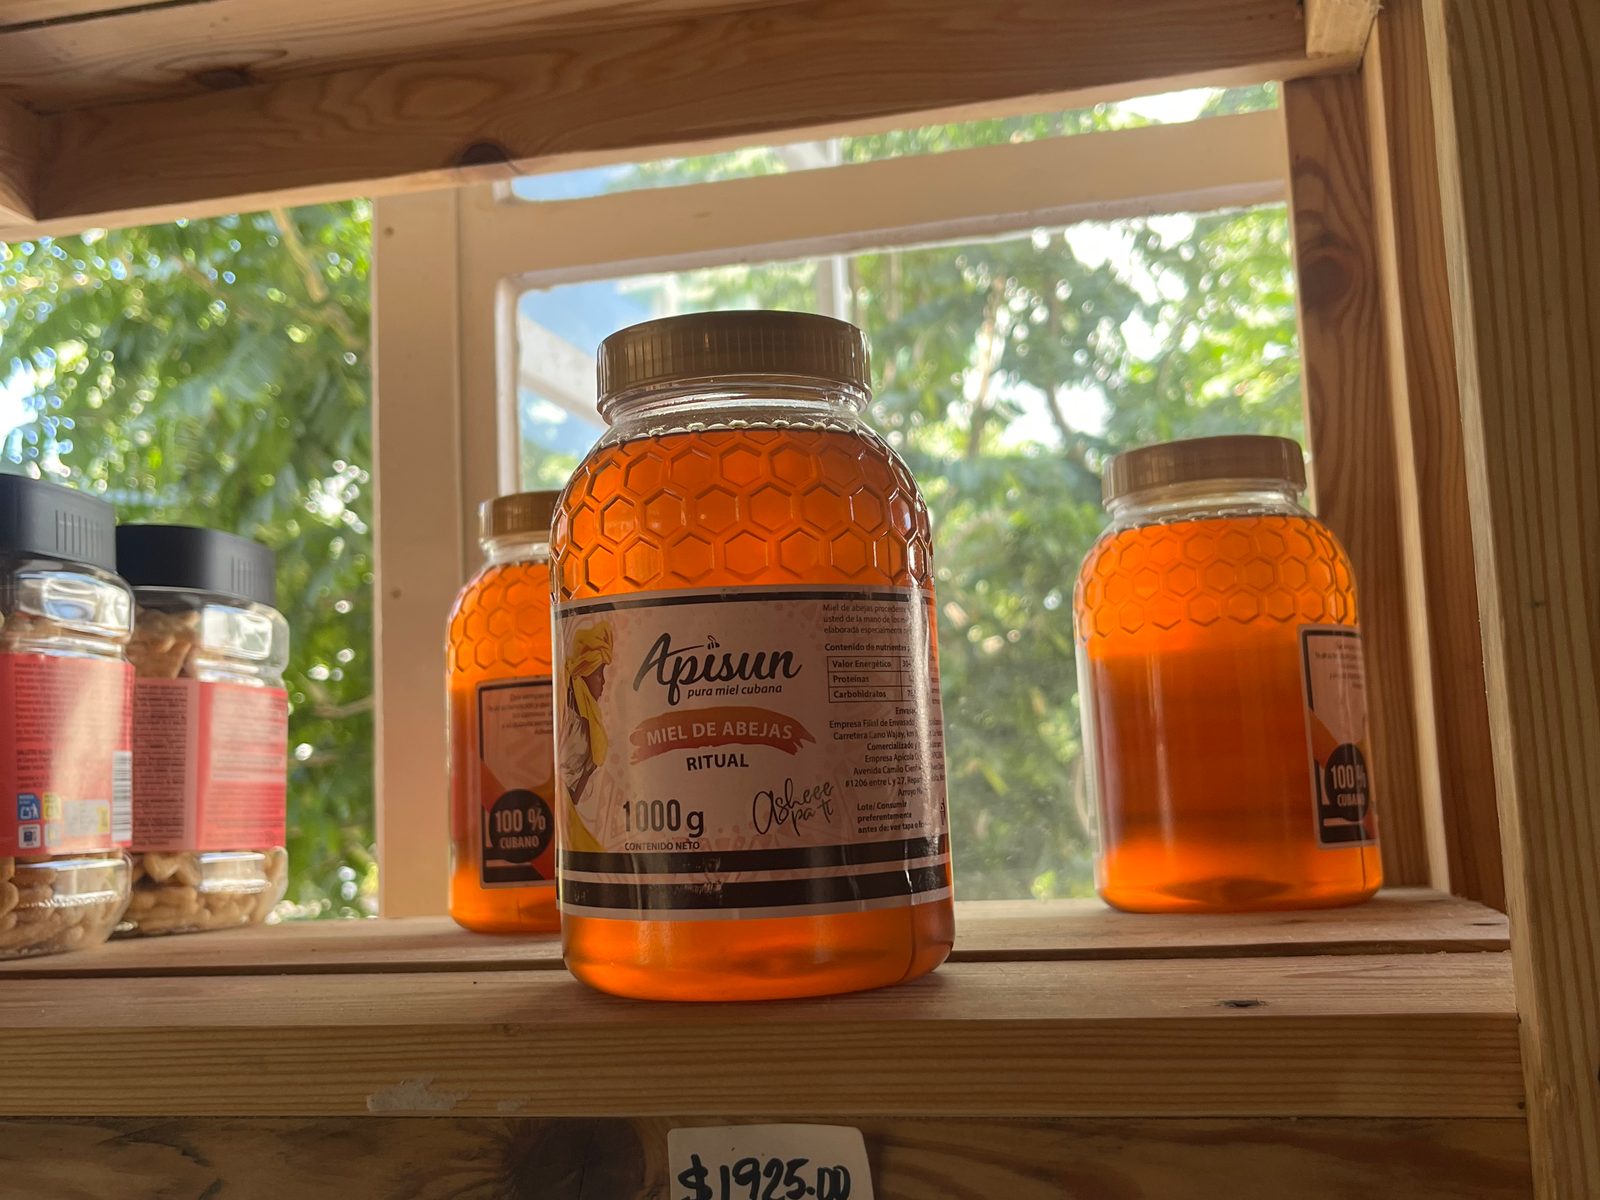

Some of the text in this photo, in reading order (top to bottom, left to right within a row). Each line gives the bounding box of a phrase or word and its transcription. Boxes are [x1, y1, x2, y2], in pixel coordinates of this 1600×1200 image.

[823, 604, 839, 612] Miel
[841, 604, 850, 612] de
[852, 605, 873, 613] abejas
[823, 615, 844, 623] usted
[846, 615, 855, 623] de
[824, 626, 859, 634] elaborada
[825, 643, 865, 651] Contenido
[866, 643, 875, 651] de
[633, 633, 802, 705] Apisun
[832, 660, 853, 668] Valor
[855, 660, 891, 669] Energético
[687, 684, 783, 699] pura miel cubana
[834, 690, 886, 698] Carbohidratos
[829, 720, 861, 729] Empresa
[880, 719, 889, 727] de
[647, 721, 793, 747] MIEL DE ABEJAS
[833, 731, 868, 740] Carretera
[867, 742, 914, 751] Comercializado
[686, 753, 749, 771] RITUAL
[865, 754, 893, 763] Empresa
[853, 767, 881, 776] Avenida
[882, 765, 904, 774] Camilo
[1331, 764, 1354, 790] 100
[845, 779, 868, 788] #1206
[869, 779, 887, 787] entre
[898, 788, 916, 797] Arroyo
[857, 801, 907, 811] Lote/ Consumir
[495, 806, 546, 833] 100 %
[622, 799, 704, 838] 1000 g
[857, 812, 912, 824] preferentemente
[858, 825, 877, 833] antes
[879, 824, 890, 832] de:
[890, 824, 901, 832] ver
[902, 822, 914, 831] tapa
[499, 835, 540, 849] CUBANO
[624, 841, 700, 851] CONTENIDO NETO
[677, 1153, 851, 1200] $1925.00
